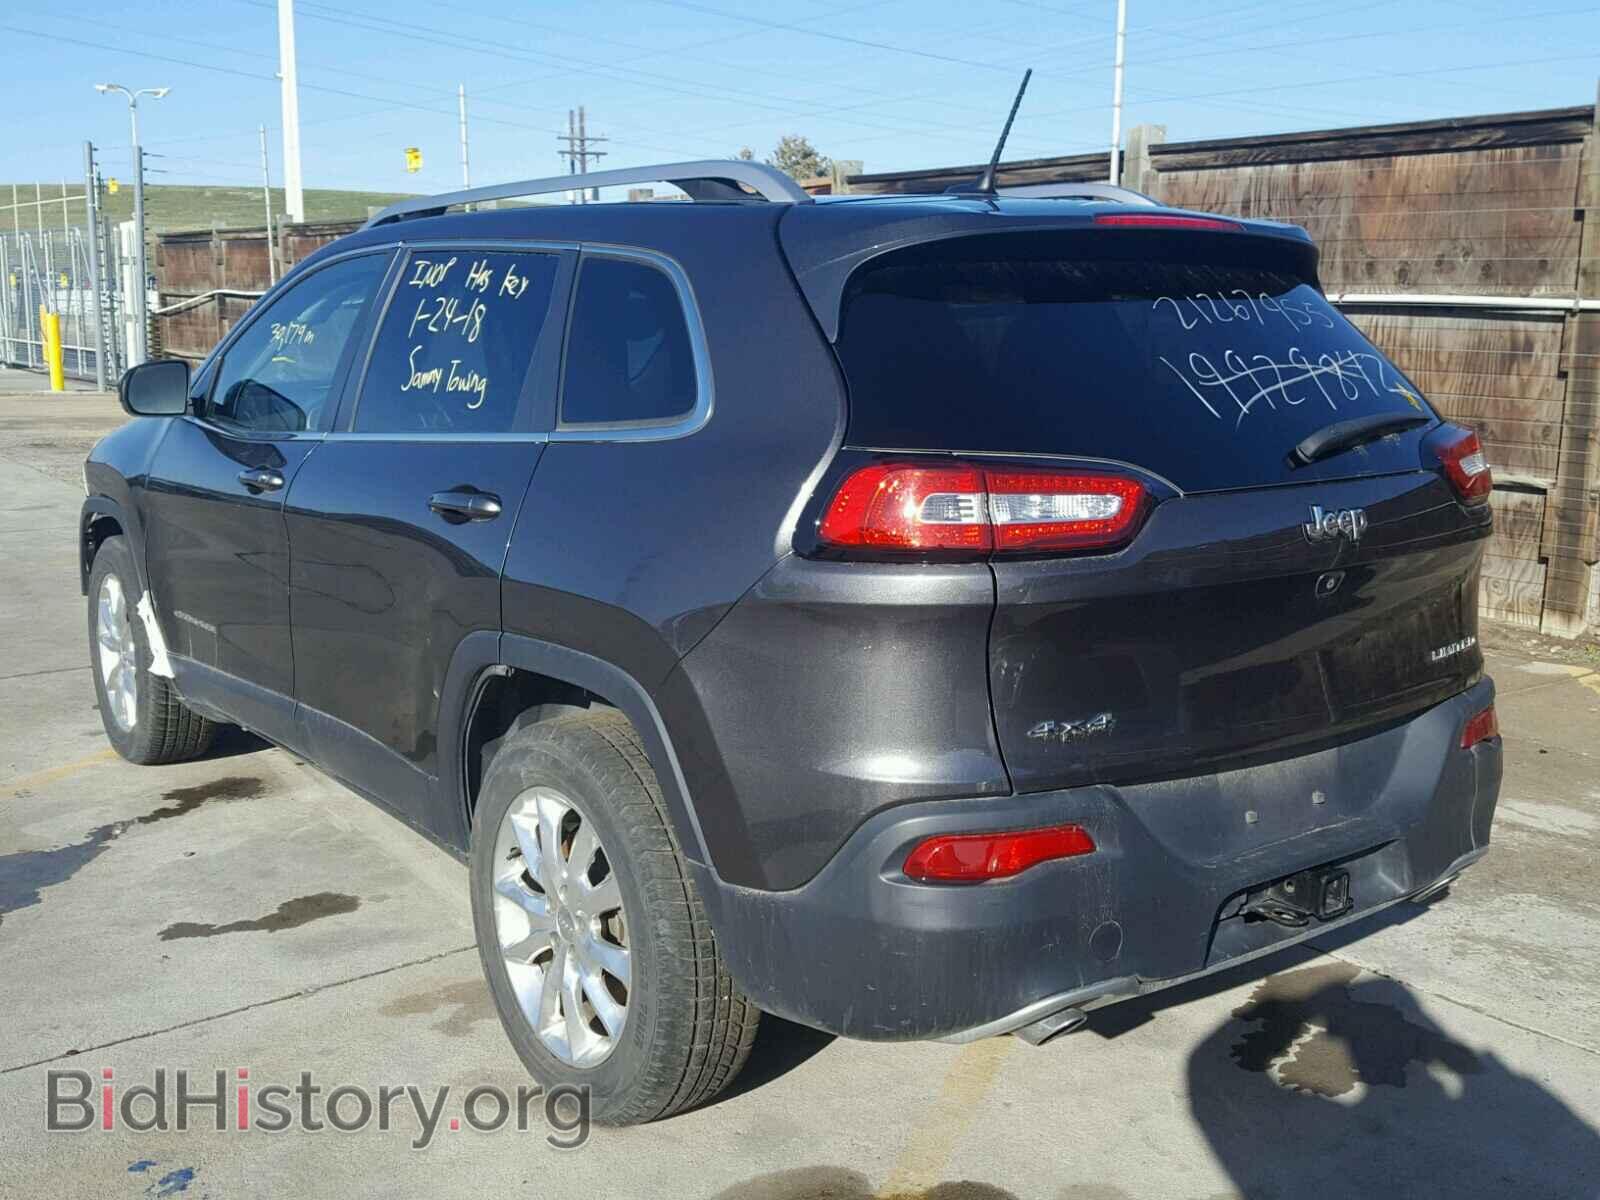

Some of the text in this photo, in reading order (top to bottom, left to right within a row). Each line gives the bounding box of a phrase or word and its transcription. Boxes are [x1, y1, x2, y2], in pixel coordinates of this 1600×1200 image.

[407, 296, 487, 343] 1-24-18
[447, 359, 488, 409] Towing
[1304, 504, 1367, 541] Jeep
